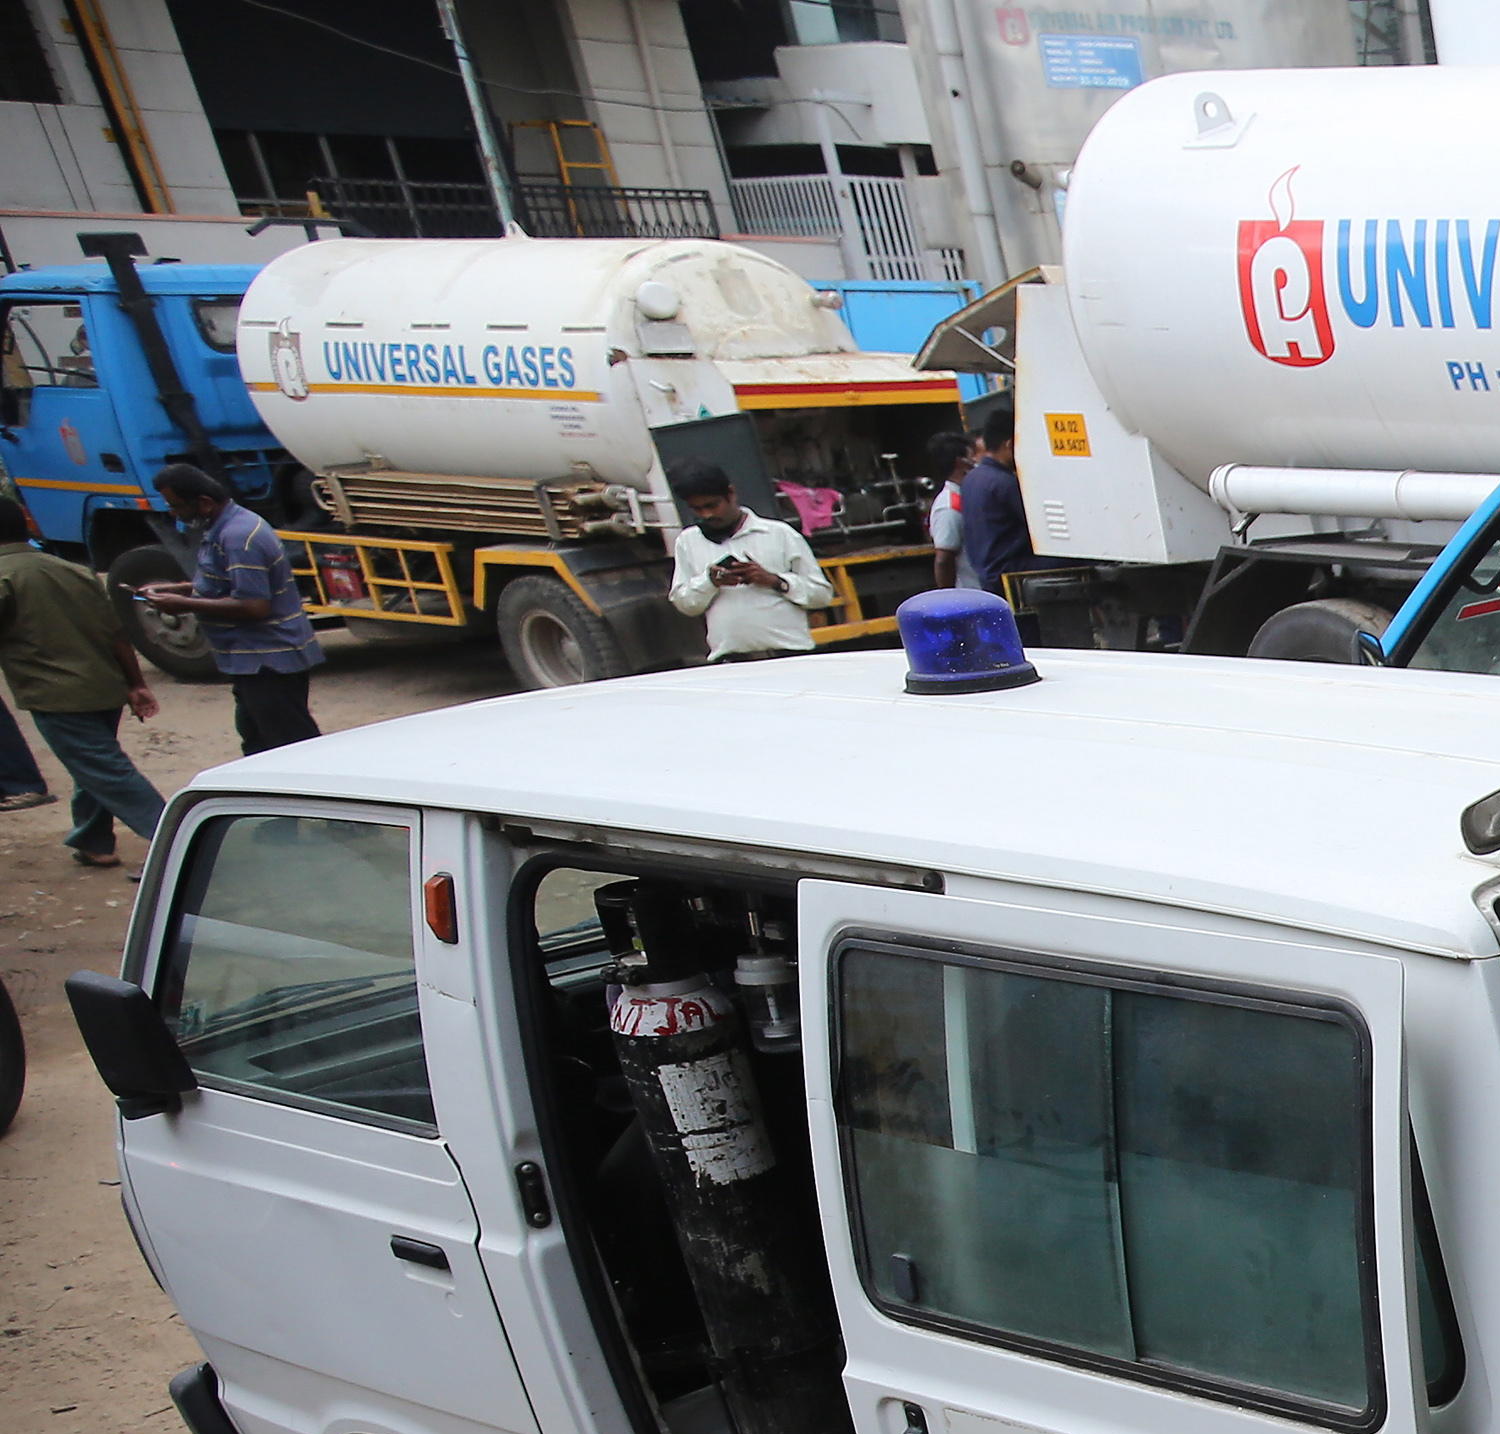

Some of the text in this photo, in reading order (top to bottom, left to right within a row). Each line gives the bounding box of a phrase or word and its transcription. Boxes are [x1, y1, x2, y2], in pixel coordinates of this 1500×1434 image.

[322, 340, 577, 388] UNIVERSAL GASES
[1446, 360, 1491, 392] PH
